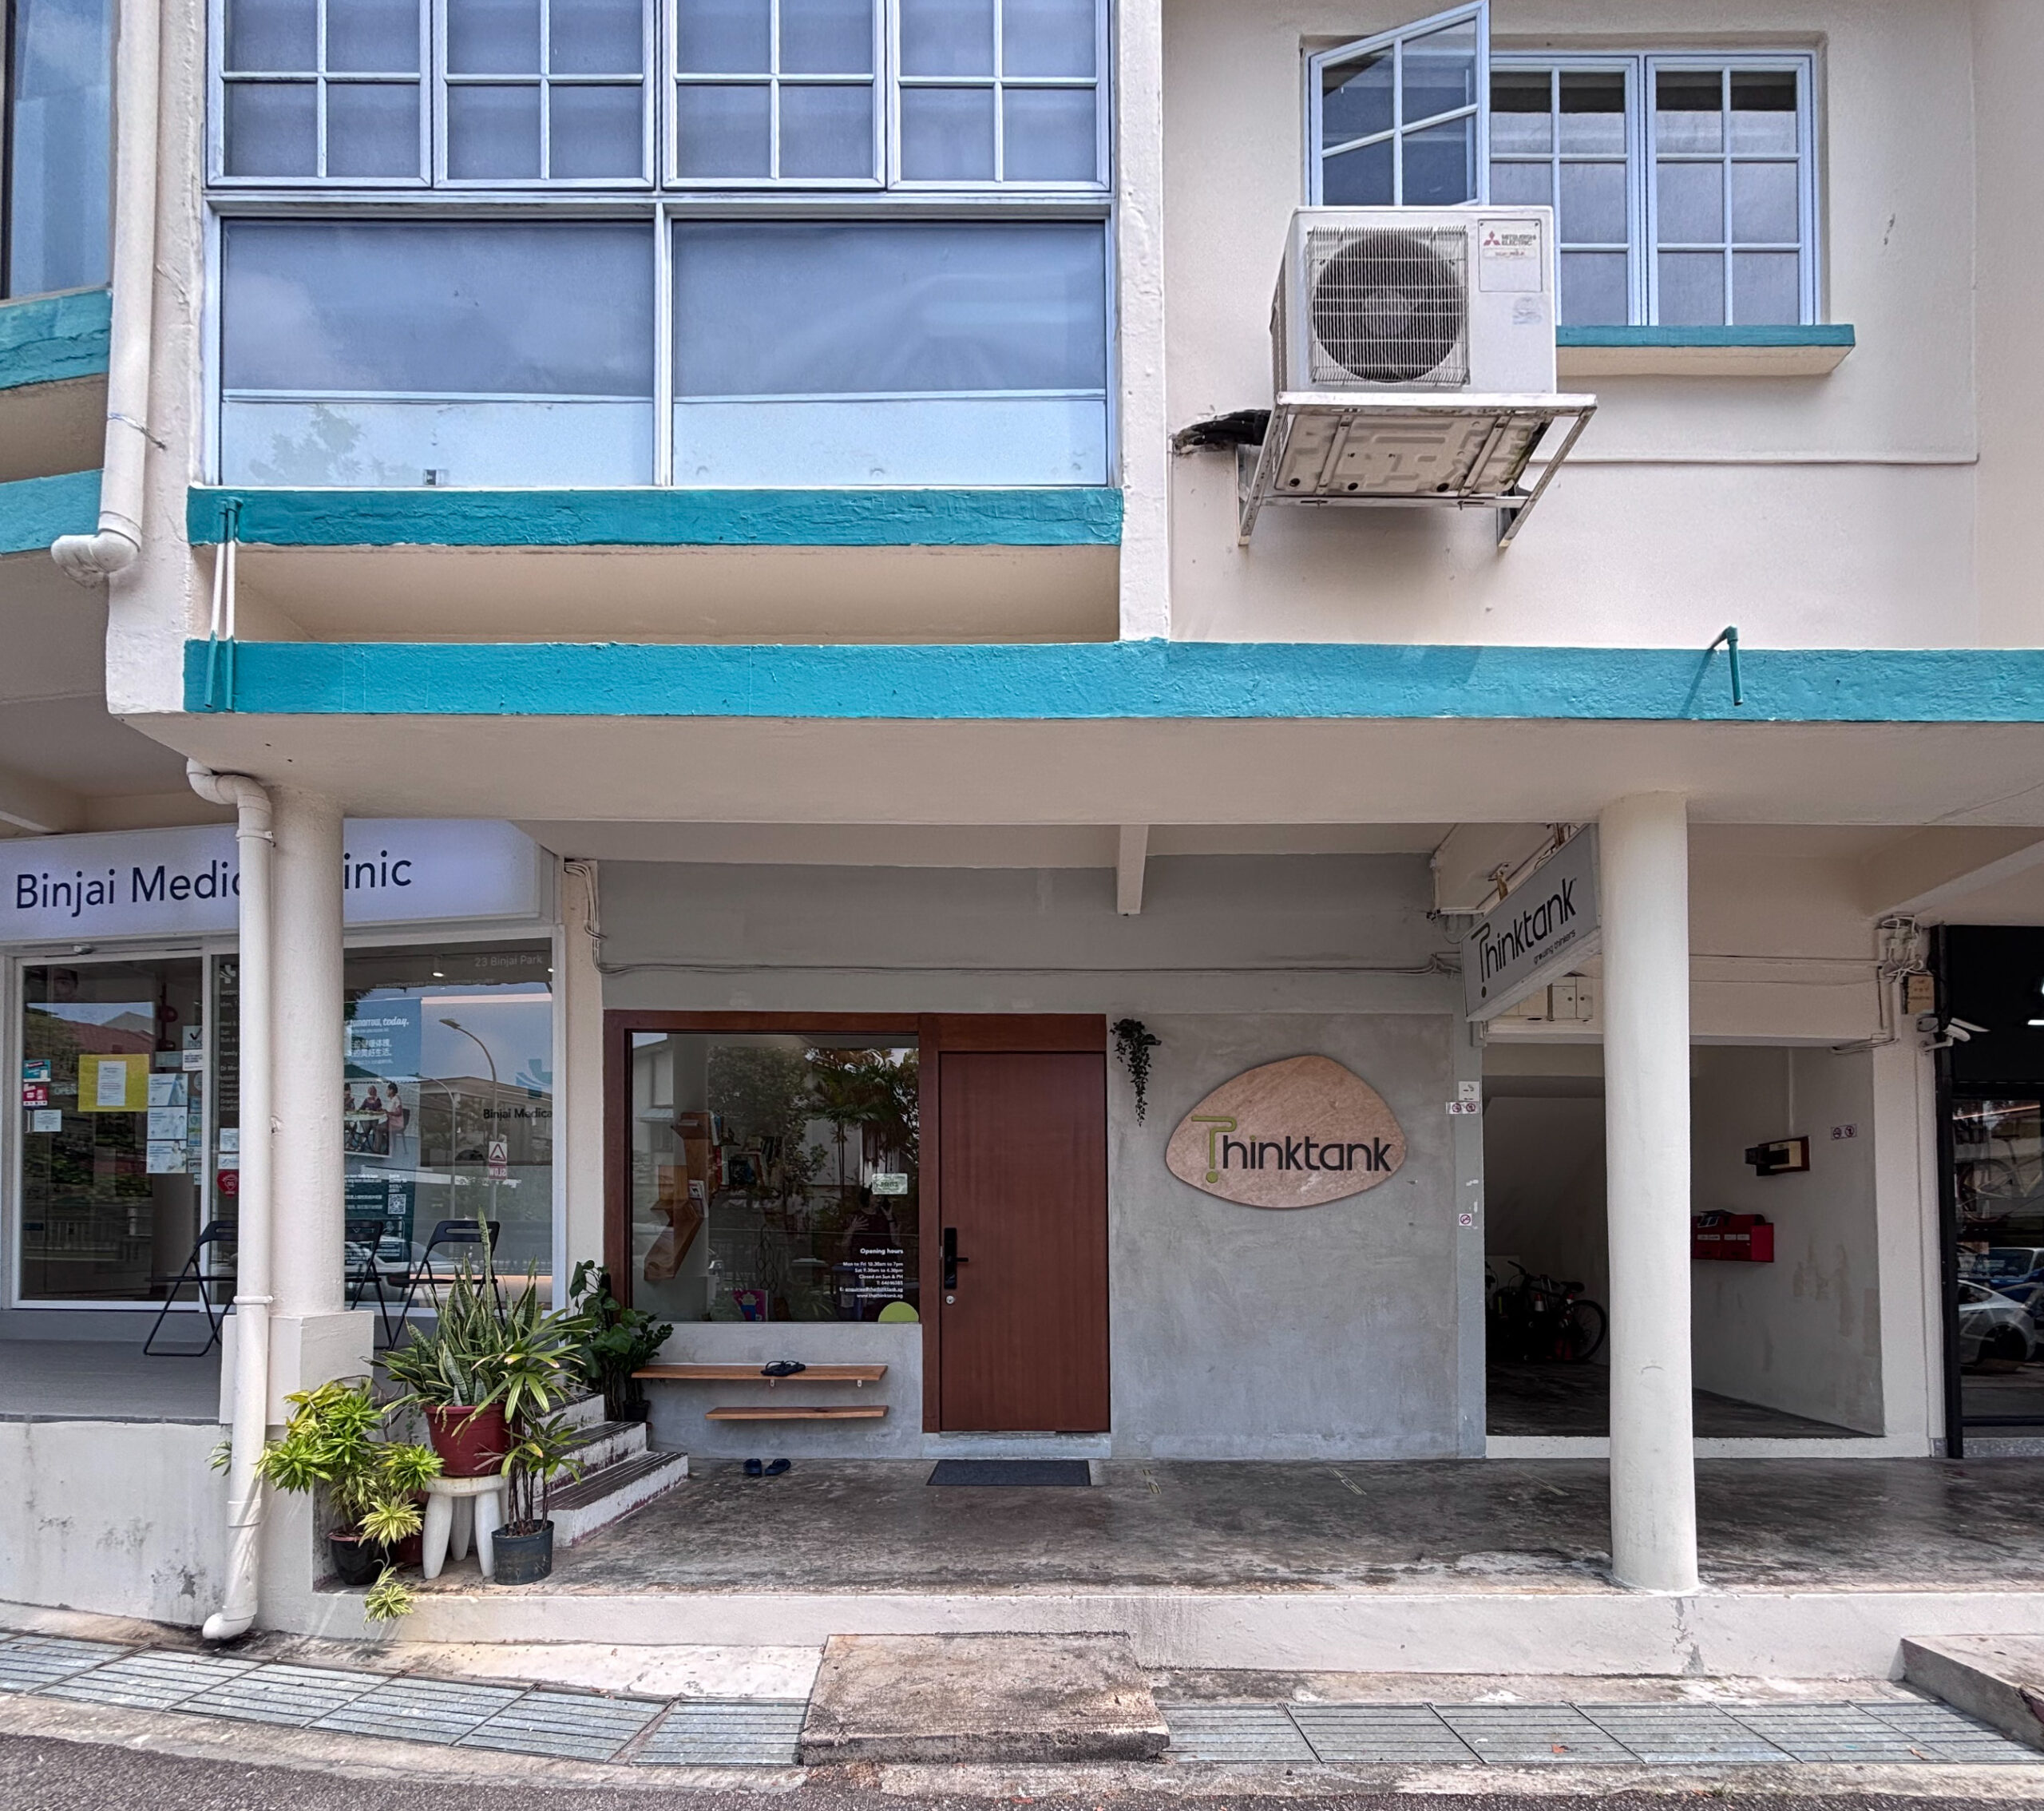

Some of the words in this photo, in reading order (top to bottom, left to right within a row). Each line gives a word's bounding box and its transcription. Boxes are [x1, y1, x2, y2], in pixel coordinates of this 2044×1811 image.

[16, 868, 116, 917] Binjai
[1471, 878, 1576, 998] Thinktank
[475, 957, 488, 967] 23
[490, 956, 517, 968] Binjai
[520, 953, 543, 965] Park
[382, 1016, 410, 1027] today.
[53, 1087, 77, 1096] OPEN
[483, 1108, 511, 1121] Binjai
[1191, 1116, 1392, 1183] Thinktank
